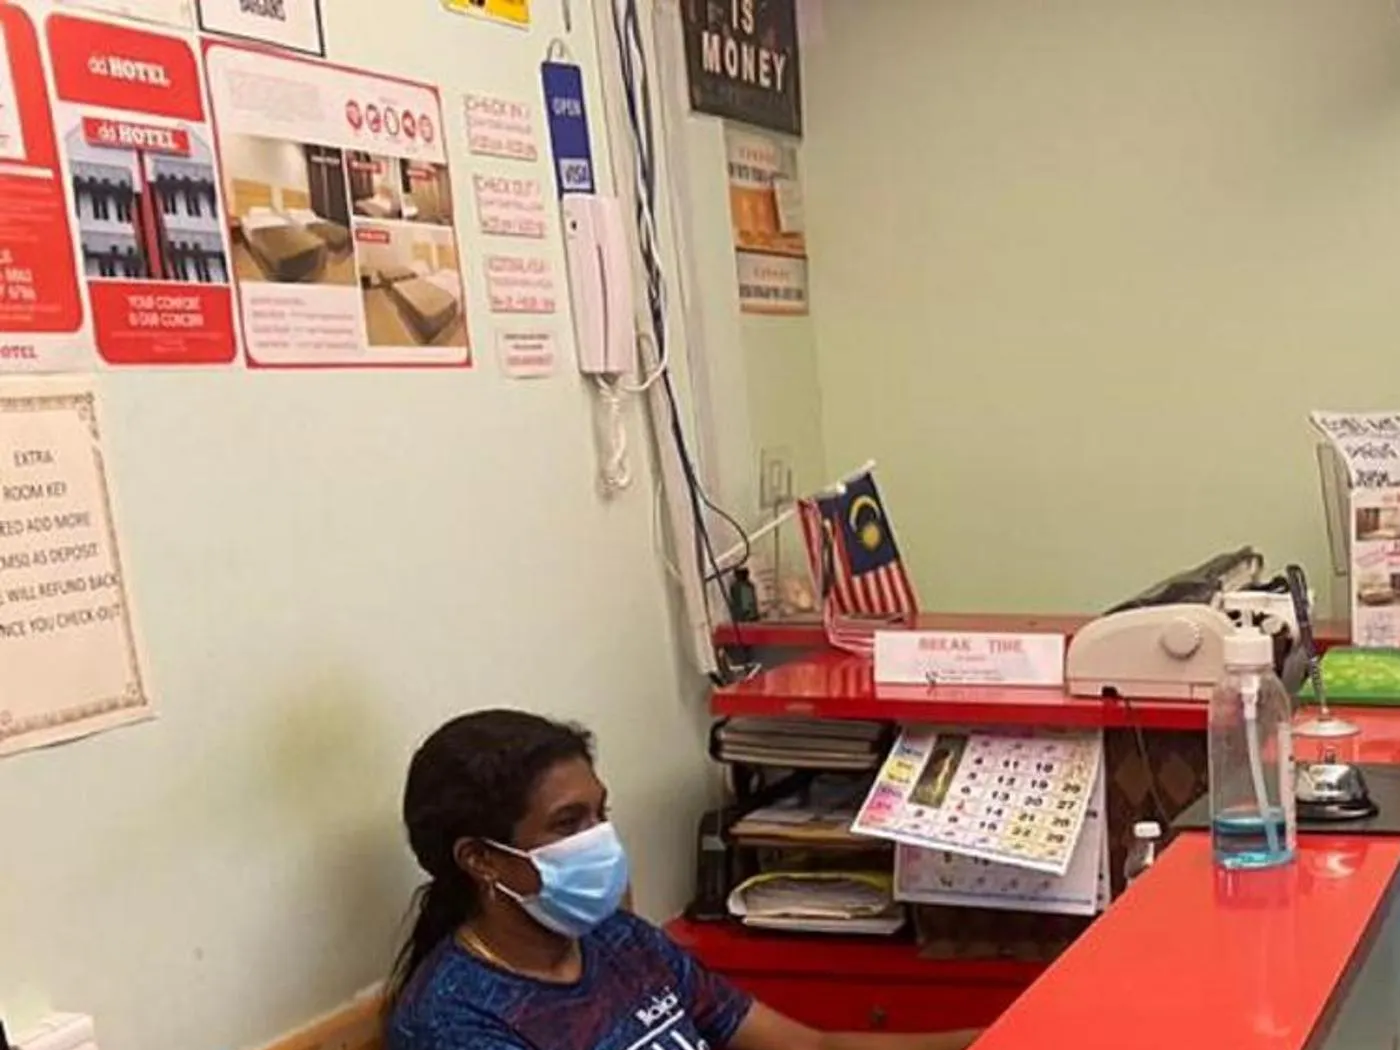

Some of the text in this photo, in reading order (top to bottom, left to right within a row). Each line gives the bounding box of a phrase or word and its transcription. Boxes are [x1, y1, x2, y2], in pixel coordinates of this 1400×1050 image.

[731, 0, 754, 34] IS
[701, 30, 787, 92] MONEY
[108, 57, 172, 88] HOTEL
[552, 97, 582, 116] OPEN
[118, 125, 181, 150] HOTEL
[564, 163, 588, 184] VISA
[0, 344, 39, 360] OTEL
[14, 449, 55, 468] EXTRA
[2, 480, 67, 501] ROOM KEY
[0, 511, 91, 537] EED ADD MORE
[49, 542, 98, 563] DEPOSIT
[39, 578, 87, 597] REFUND
[0, 619, 26, 638] NCE
[918, 637, 1024, 653] BREAK TIME
